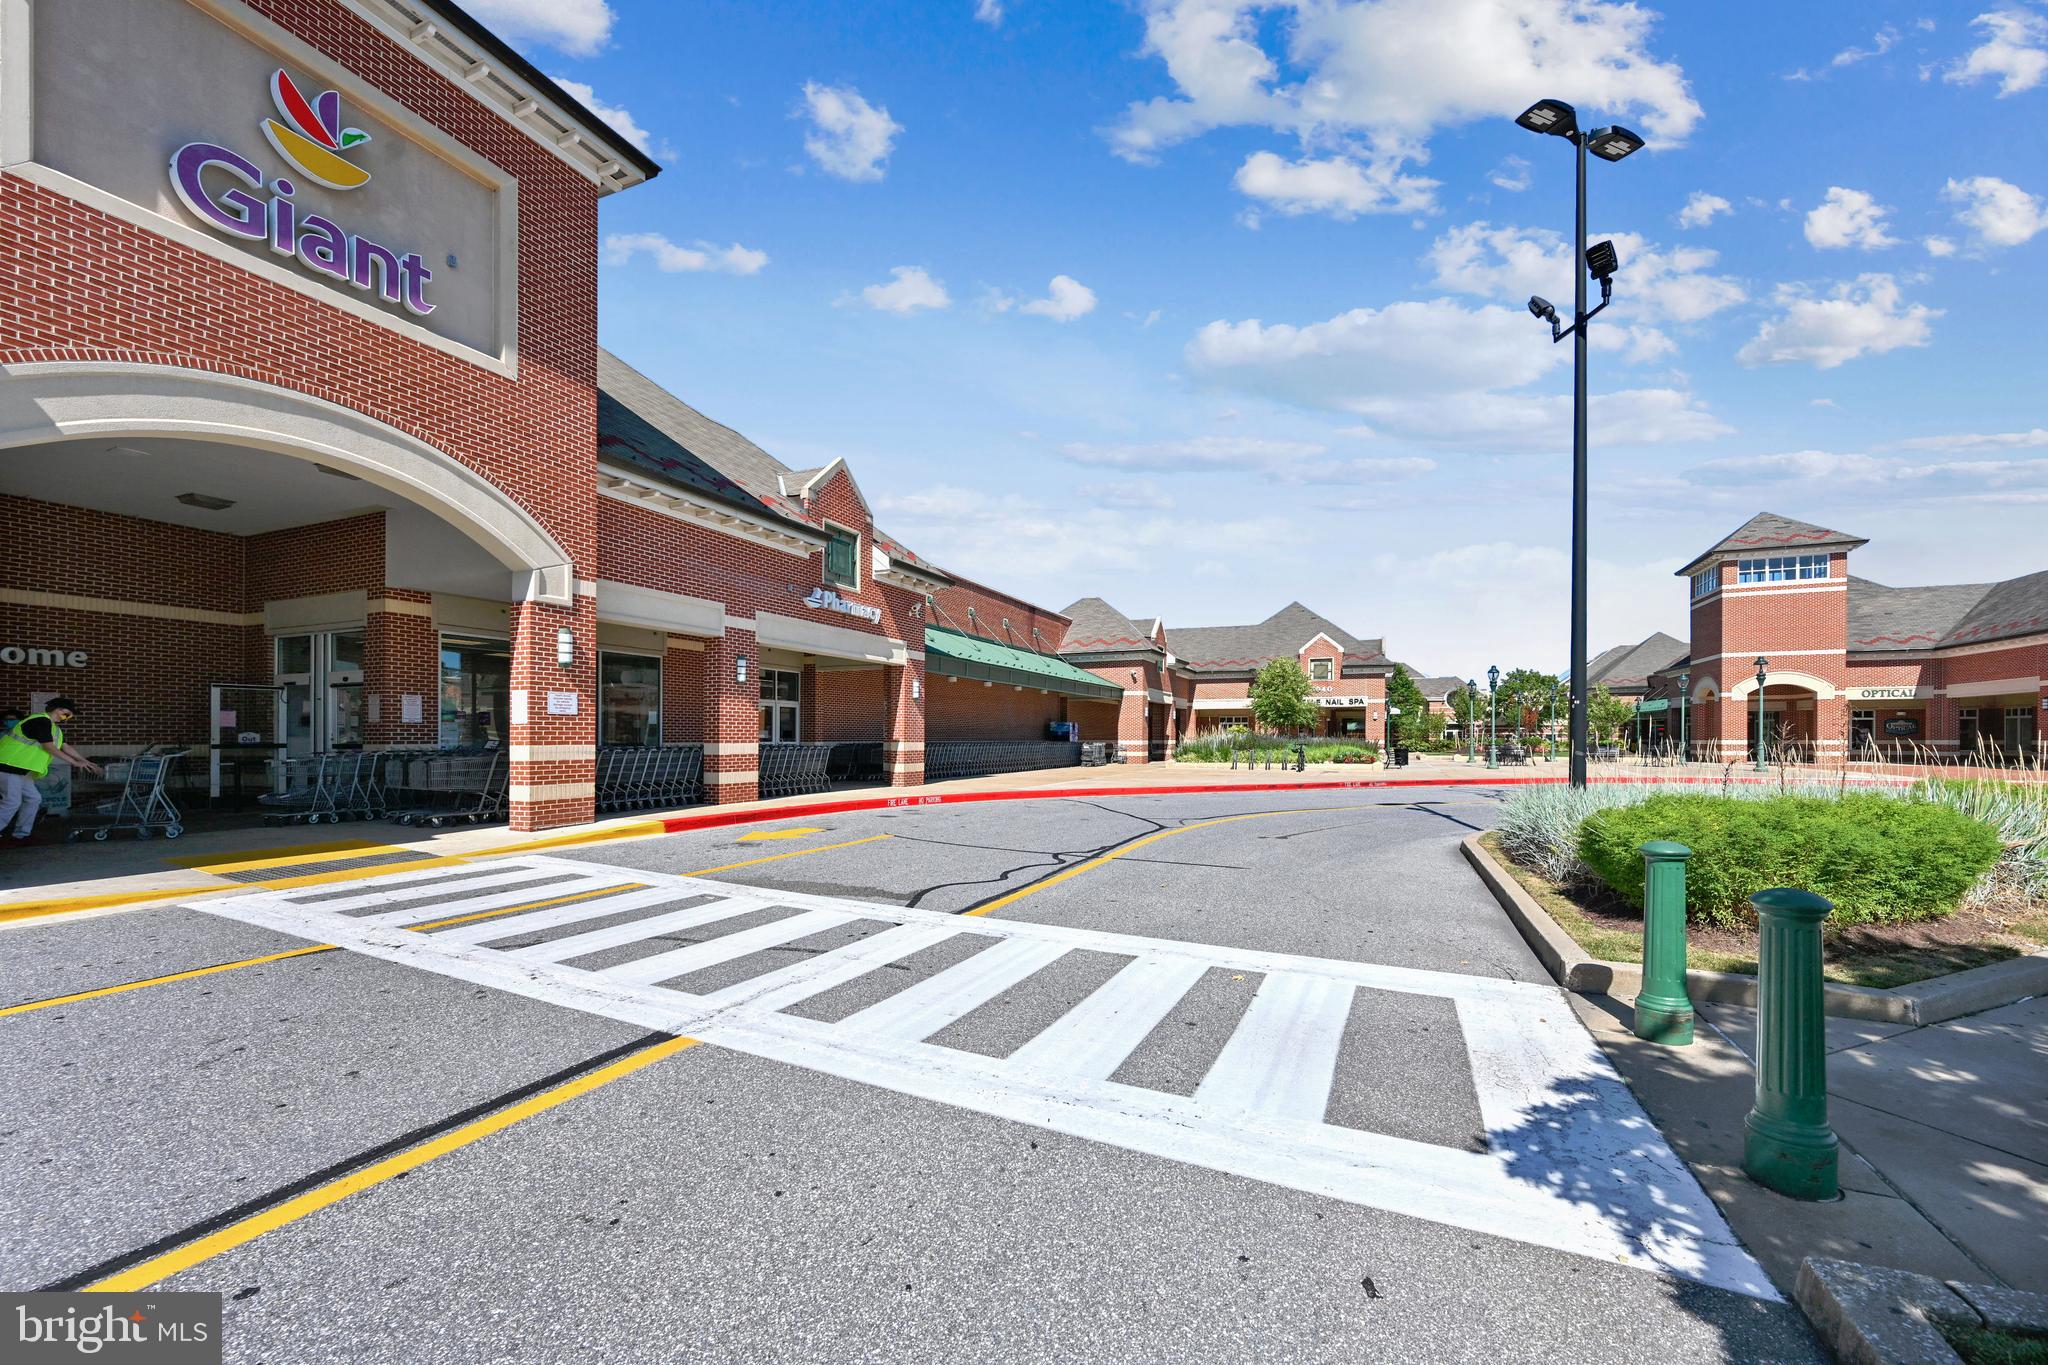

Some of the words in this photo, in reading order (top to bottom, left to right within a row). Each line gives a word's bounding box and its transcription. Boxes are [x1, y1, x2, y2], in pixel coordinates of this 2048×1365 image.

[169, 141, 437, 316] Giant
[823, 590, 881, 625] Pharmacy
[0, 646, 88, 668] ome
